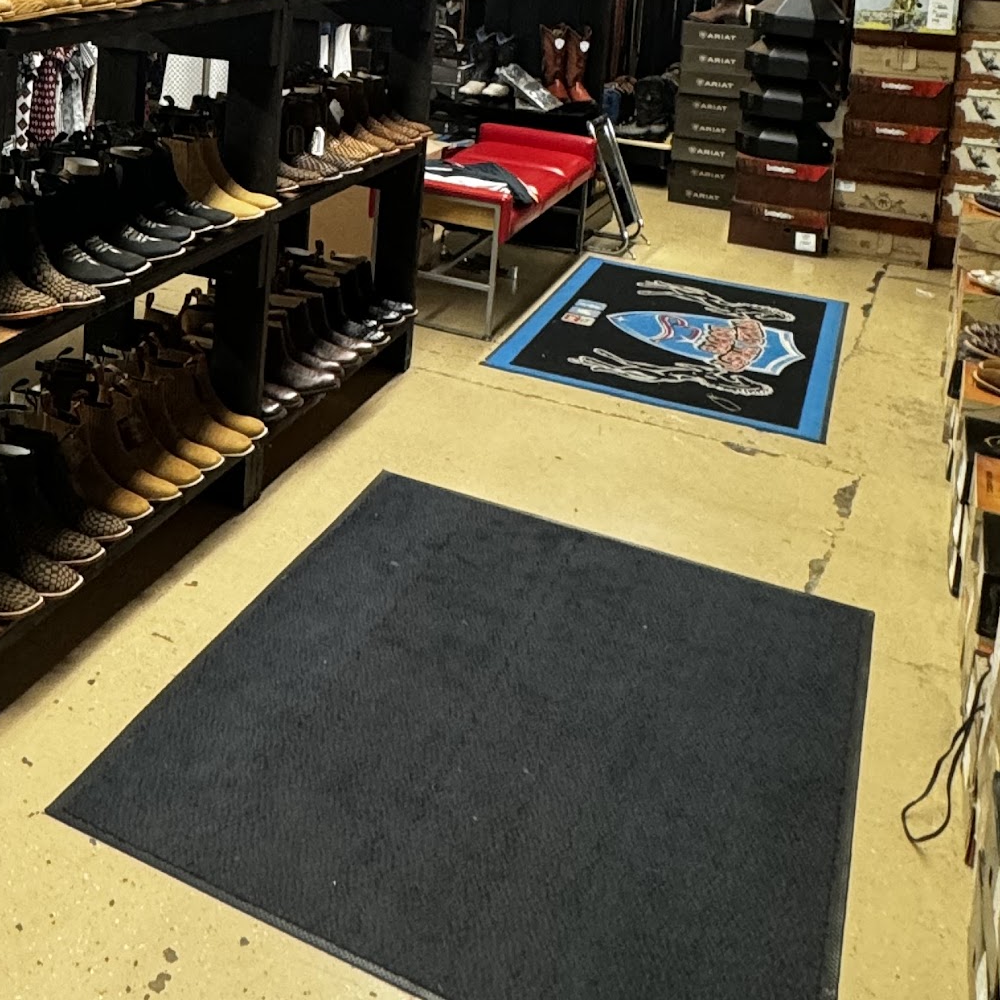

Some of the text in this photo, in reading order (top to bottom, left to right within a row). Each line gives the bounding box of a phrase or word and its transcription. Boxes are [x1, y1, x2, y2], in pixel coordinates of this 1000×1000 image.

[707, 32, 737, 41] ARIAT
[707, 57, 737, 65] ARIAT
[704, 81, 735, 89] ARIAT
[700, 103, 728, 111] ARIAT
[698, 126, 727, 134] ARIAT
[696, 148, 726, 157] ARIAT
